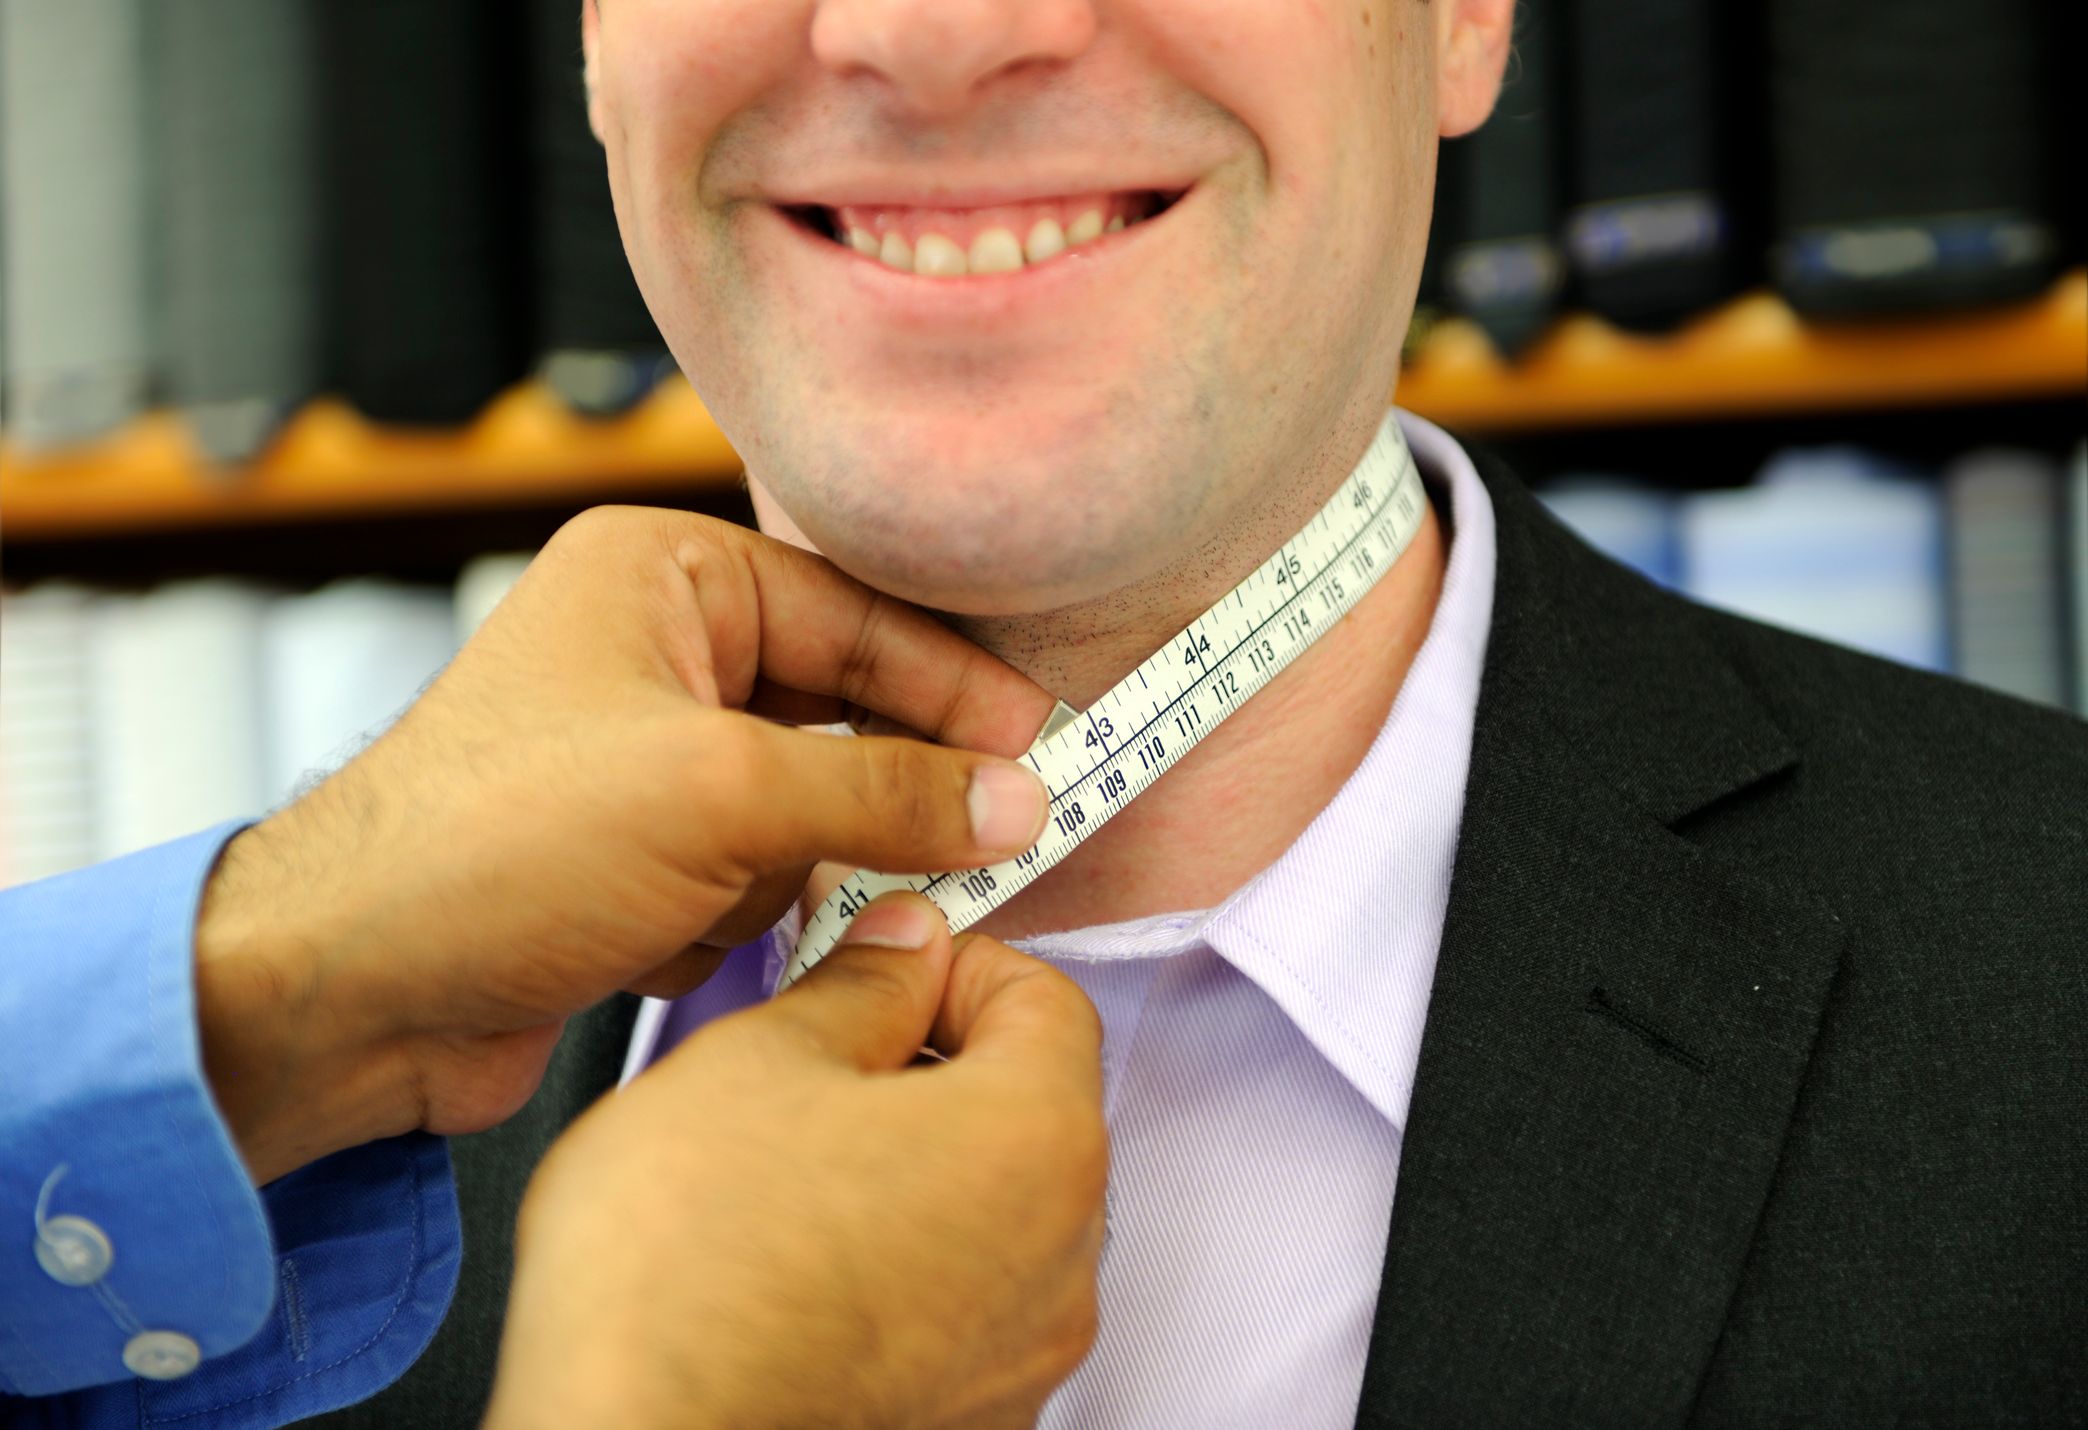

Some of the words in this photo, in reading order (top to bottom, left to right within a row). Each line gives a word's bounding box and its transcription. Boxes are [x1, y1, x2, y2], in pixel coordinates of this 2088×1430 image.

[839, 888, 869, 919] 41
[1084, 717, 1115, 749] 43
[1184, 634, 1211, 666] 44
[1276, 555, 1302, 585] 45
[1353, 480, 1373, 509] 46
[959, 867, 998, 903] 106
[1053, 801, 1086, 838] 108
[1096, 769, 1127, 804] 109
[1137, 735, 1166, 771] 110
[1175, 704, 1201, 737] 111
[1211, 671, 1239, 705] 112
[1248, 639, 1275, 673] 113
[1284, 609, 1312, 641] 114
[1319, 577, 1345, 610] 115
[1351, 547, 1374, 579] 116
[1378, 519, 1398, 549] 117
